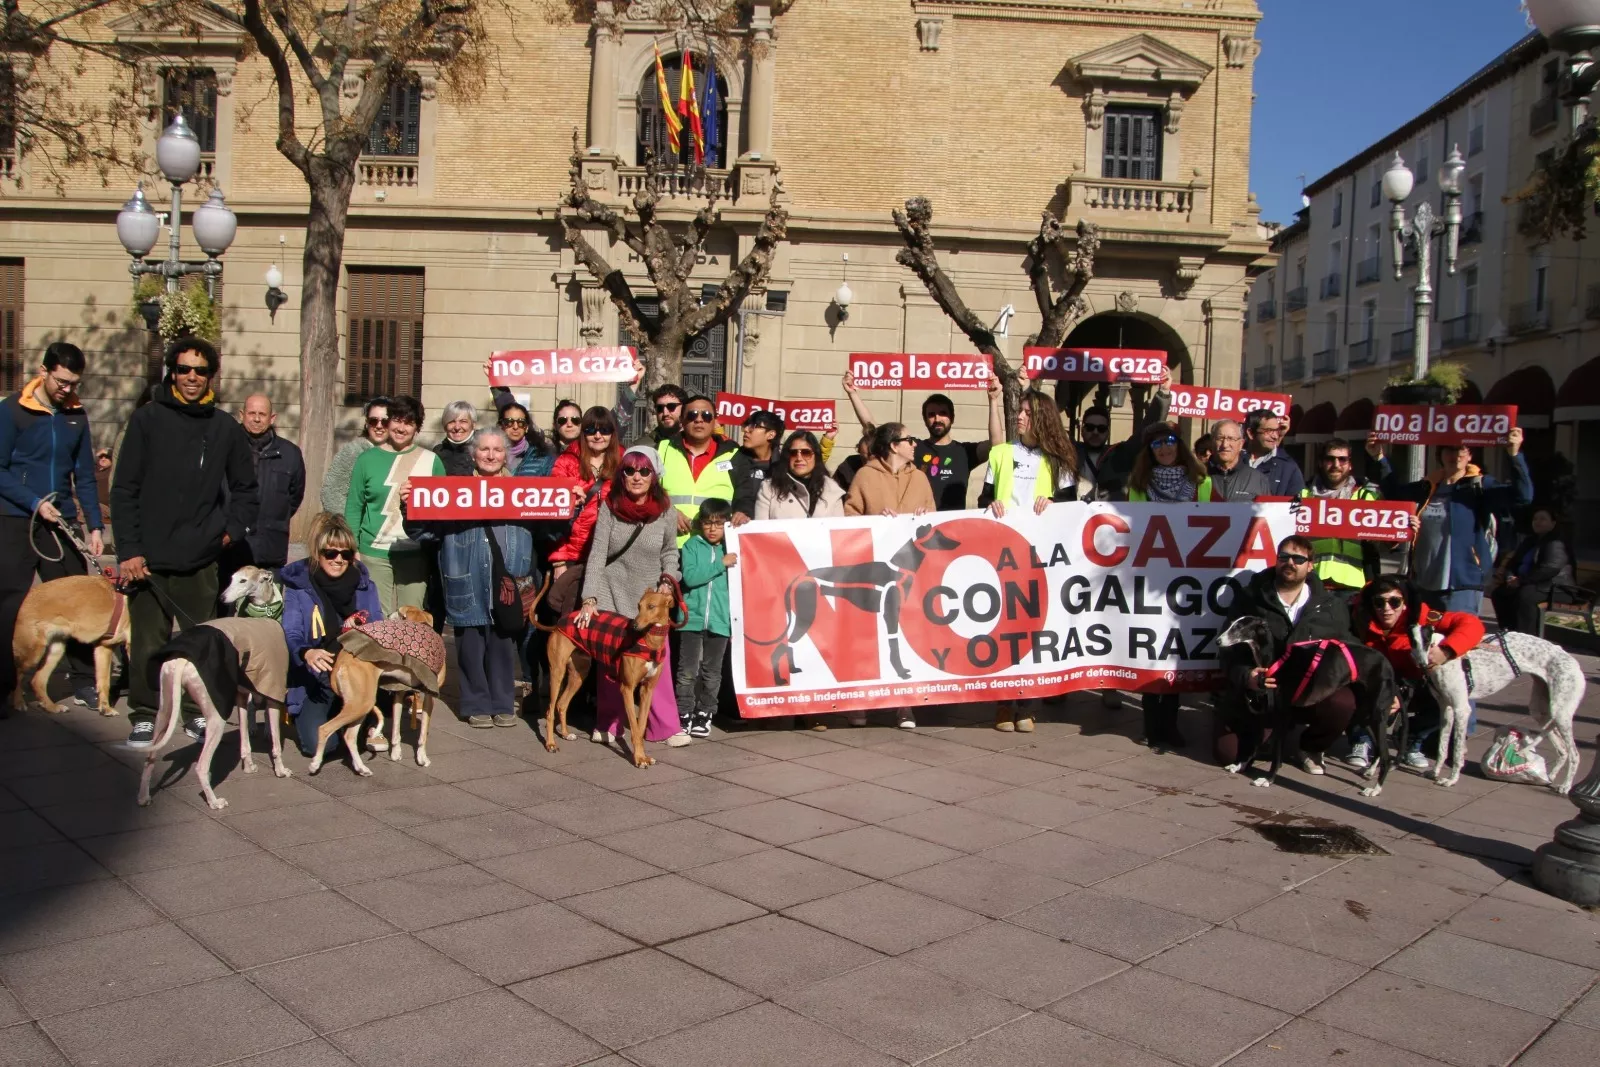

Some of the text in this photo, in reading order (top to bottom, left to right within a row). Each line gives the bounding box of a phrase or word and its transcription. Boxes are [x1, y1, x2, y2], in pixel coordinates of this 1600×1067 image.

[493, 351, 633, 377] no a la caza
[853, 355, 988, 379] no a la caza
[1027, 351, 1162, 374] no a la caza
[853, 379, 902, 388] con perros
[718, 400, 746, 418] no
[790, 408, 833, 423] caza
[1170, 389, 1286, 417] no a la caza
[1178, 406, 1206, 416] perros
[1374, 407, 1509, 434] no a la caza
[1390, 432, 1420, 442] perros
[413, 480, 570, 508] no a la caza
[1296, 505, 1312, 524] a
[1318, 500, 1342, 526] la
[1349, 508, 1409, 529] caza
[1082, 515, 1277, 569] CAZA
[997, 543, 1071, 571] A LA
[922, 574, 1241, 626] CON GALGO
[931, 623, 1219, 670] Y OTRAS RAZ
[746, 695, 784, 706] Cuanto
[788, 693, 811, 703] más
[814, 689, 865, 702] indefensa
[868, 686, 891, 697] está
[893, 686, 913, 695] una
[916, 682, 962, 694] criatura,
[965, 679, 987, 690] más
[990, 676, 1035, 689] derecho
[1037, 674, 1062, 686] tiene
[1070, 670, 1083, 680] ser
[1086, 667, 1137, 680] defendida
